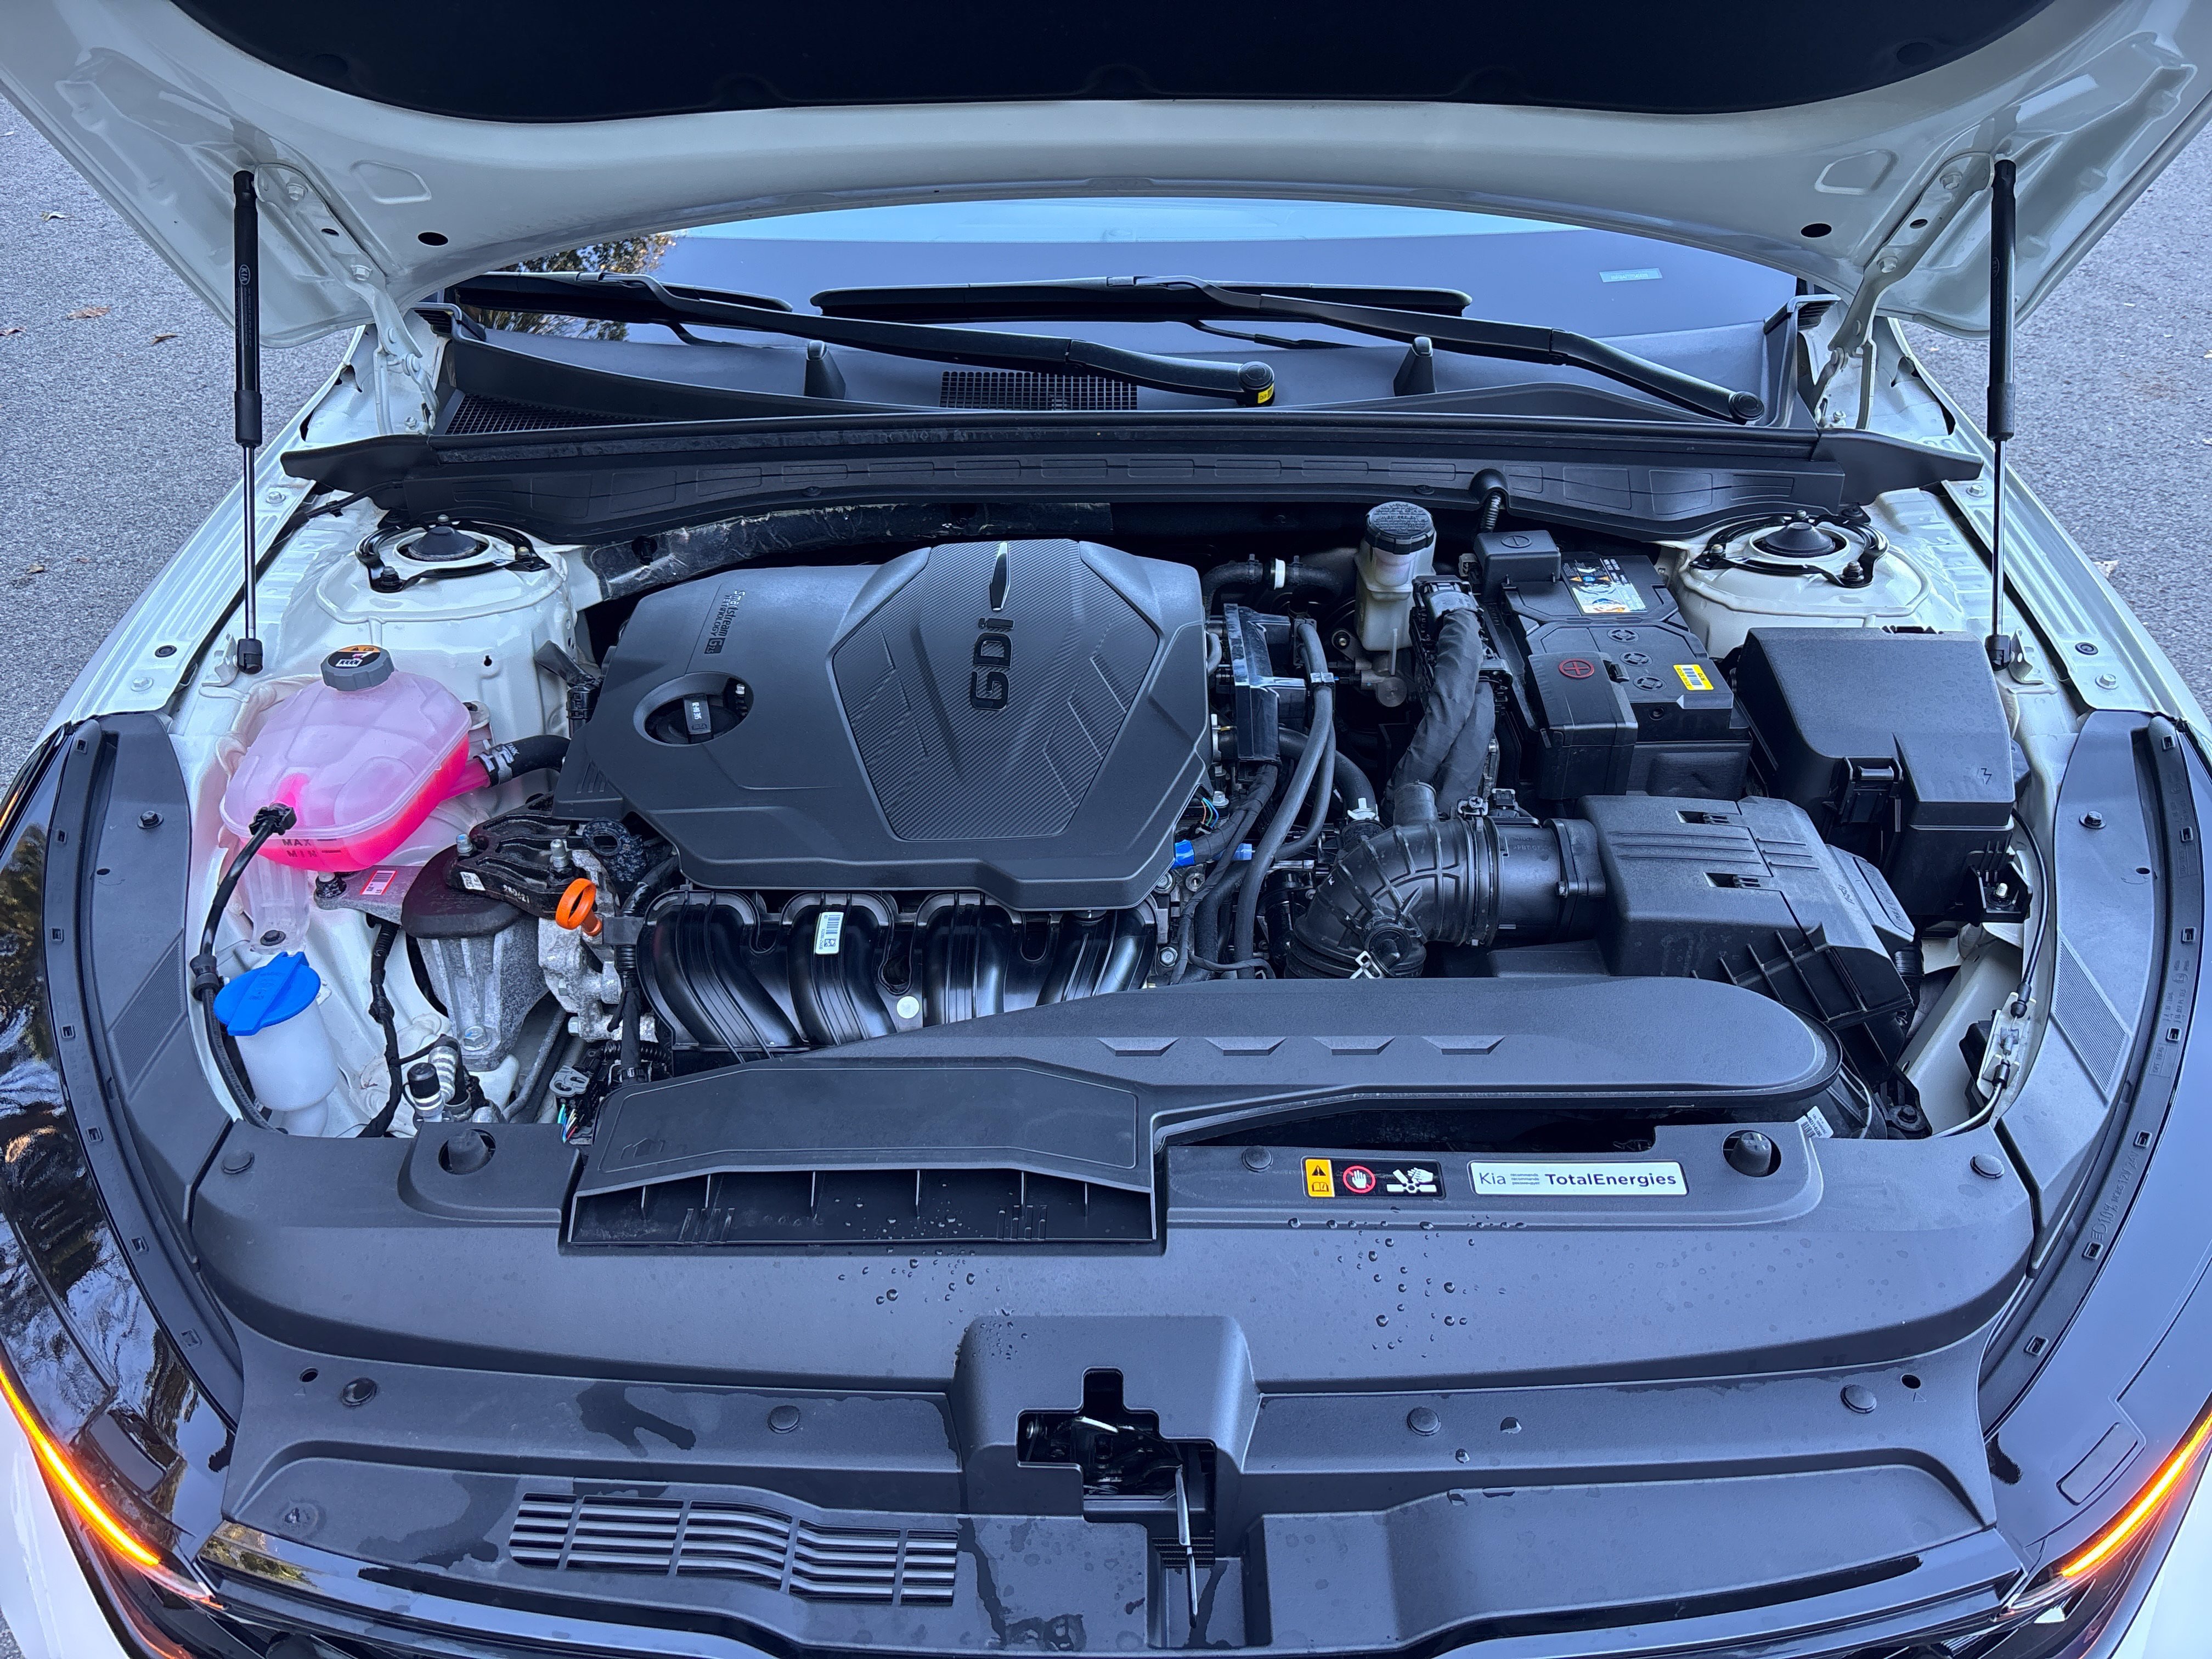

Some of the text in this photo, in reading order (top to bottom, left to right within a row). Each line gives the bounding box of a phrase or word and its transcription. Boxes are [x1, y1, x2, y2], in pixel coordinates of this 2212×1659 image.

[716, 590, 746, 637] Smartstream
[969, 618, 1014, 711] GDi
[506, 742, 520, 757] TANK
[1479, 1172, 1506, 1185] Kia
[1545, 1173, 1677, 1187] TotalEnergies
